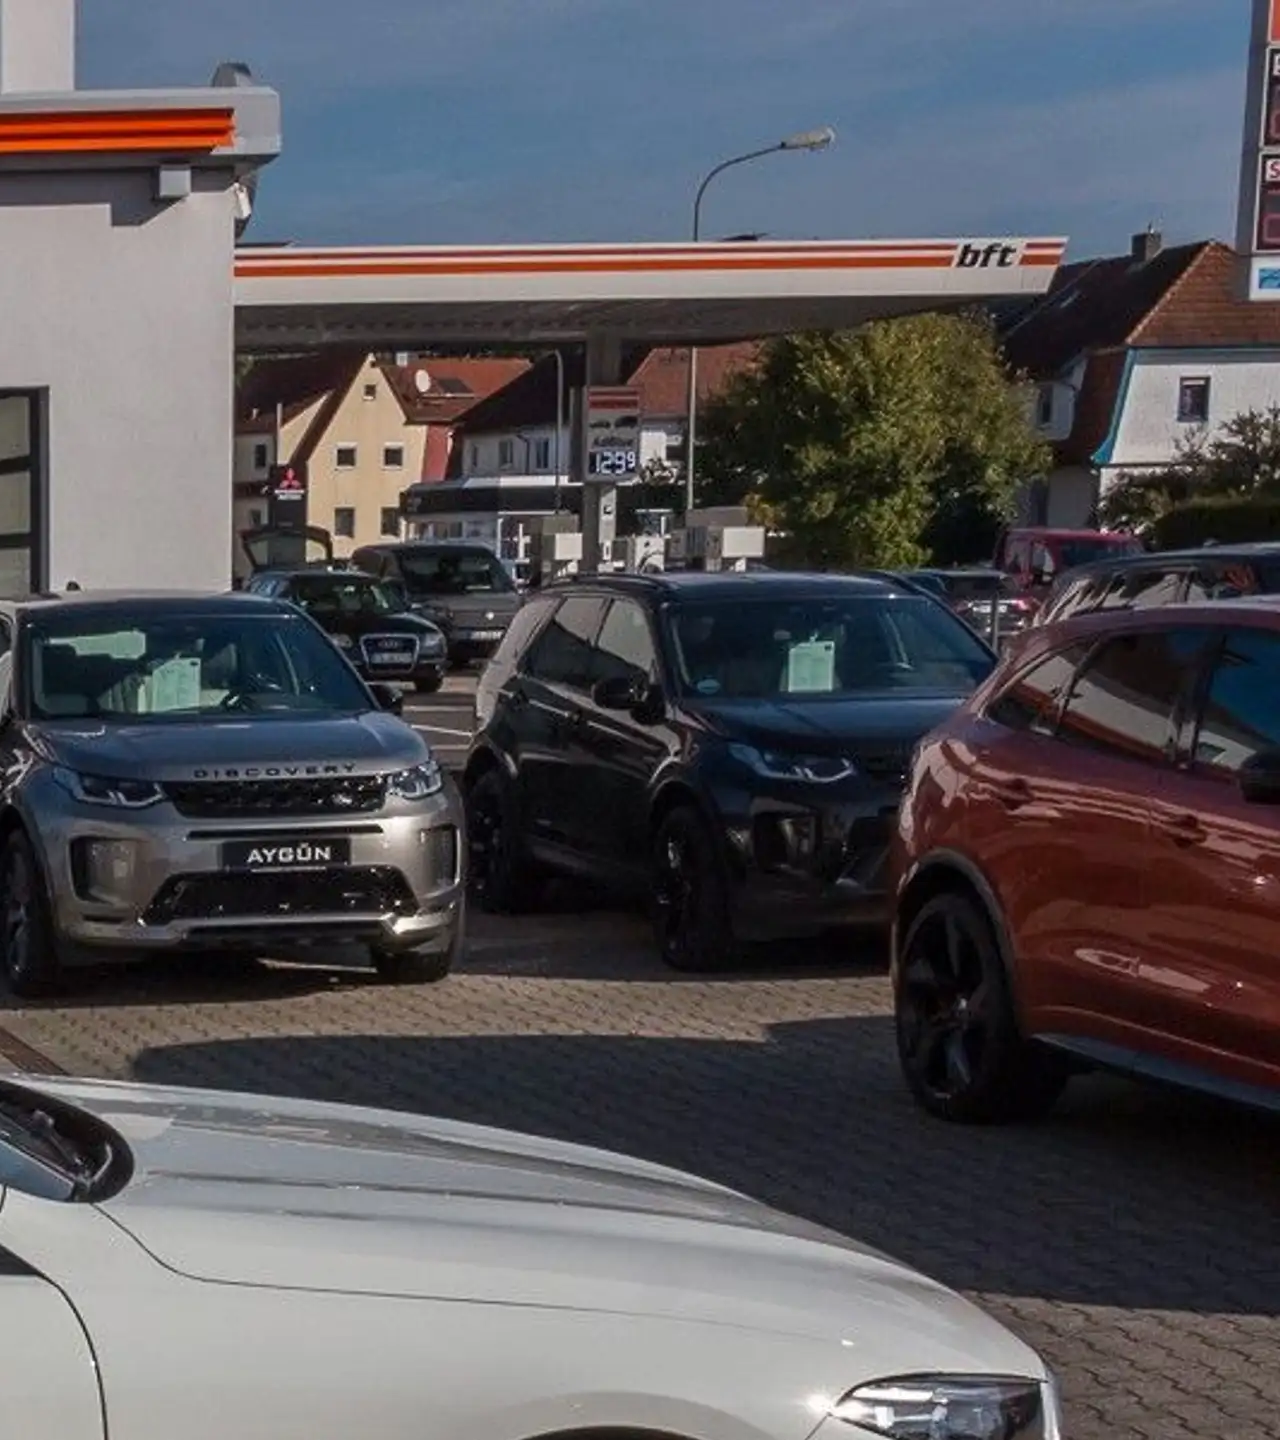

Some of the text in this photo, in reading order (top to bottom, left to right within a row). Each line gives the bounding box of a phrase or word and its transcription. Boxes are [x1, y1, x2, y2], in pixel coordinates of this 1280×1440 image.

[956, 242, 1017, 267] bft
[193, 762, 357, 779] DISCOVERY
[246, 842, 332, 865] AYGÜN
